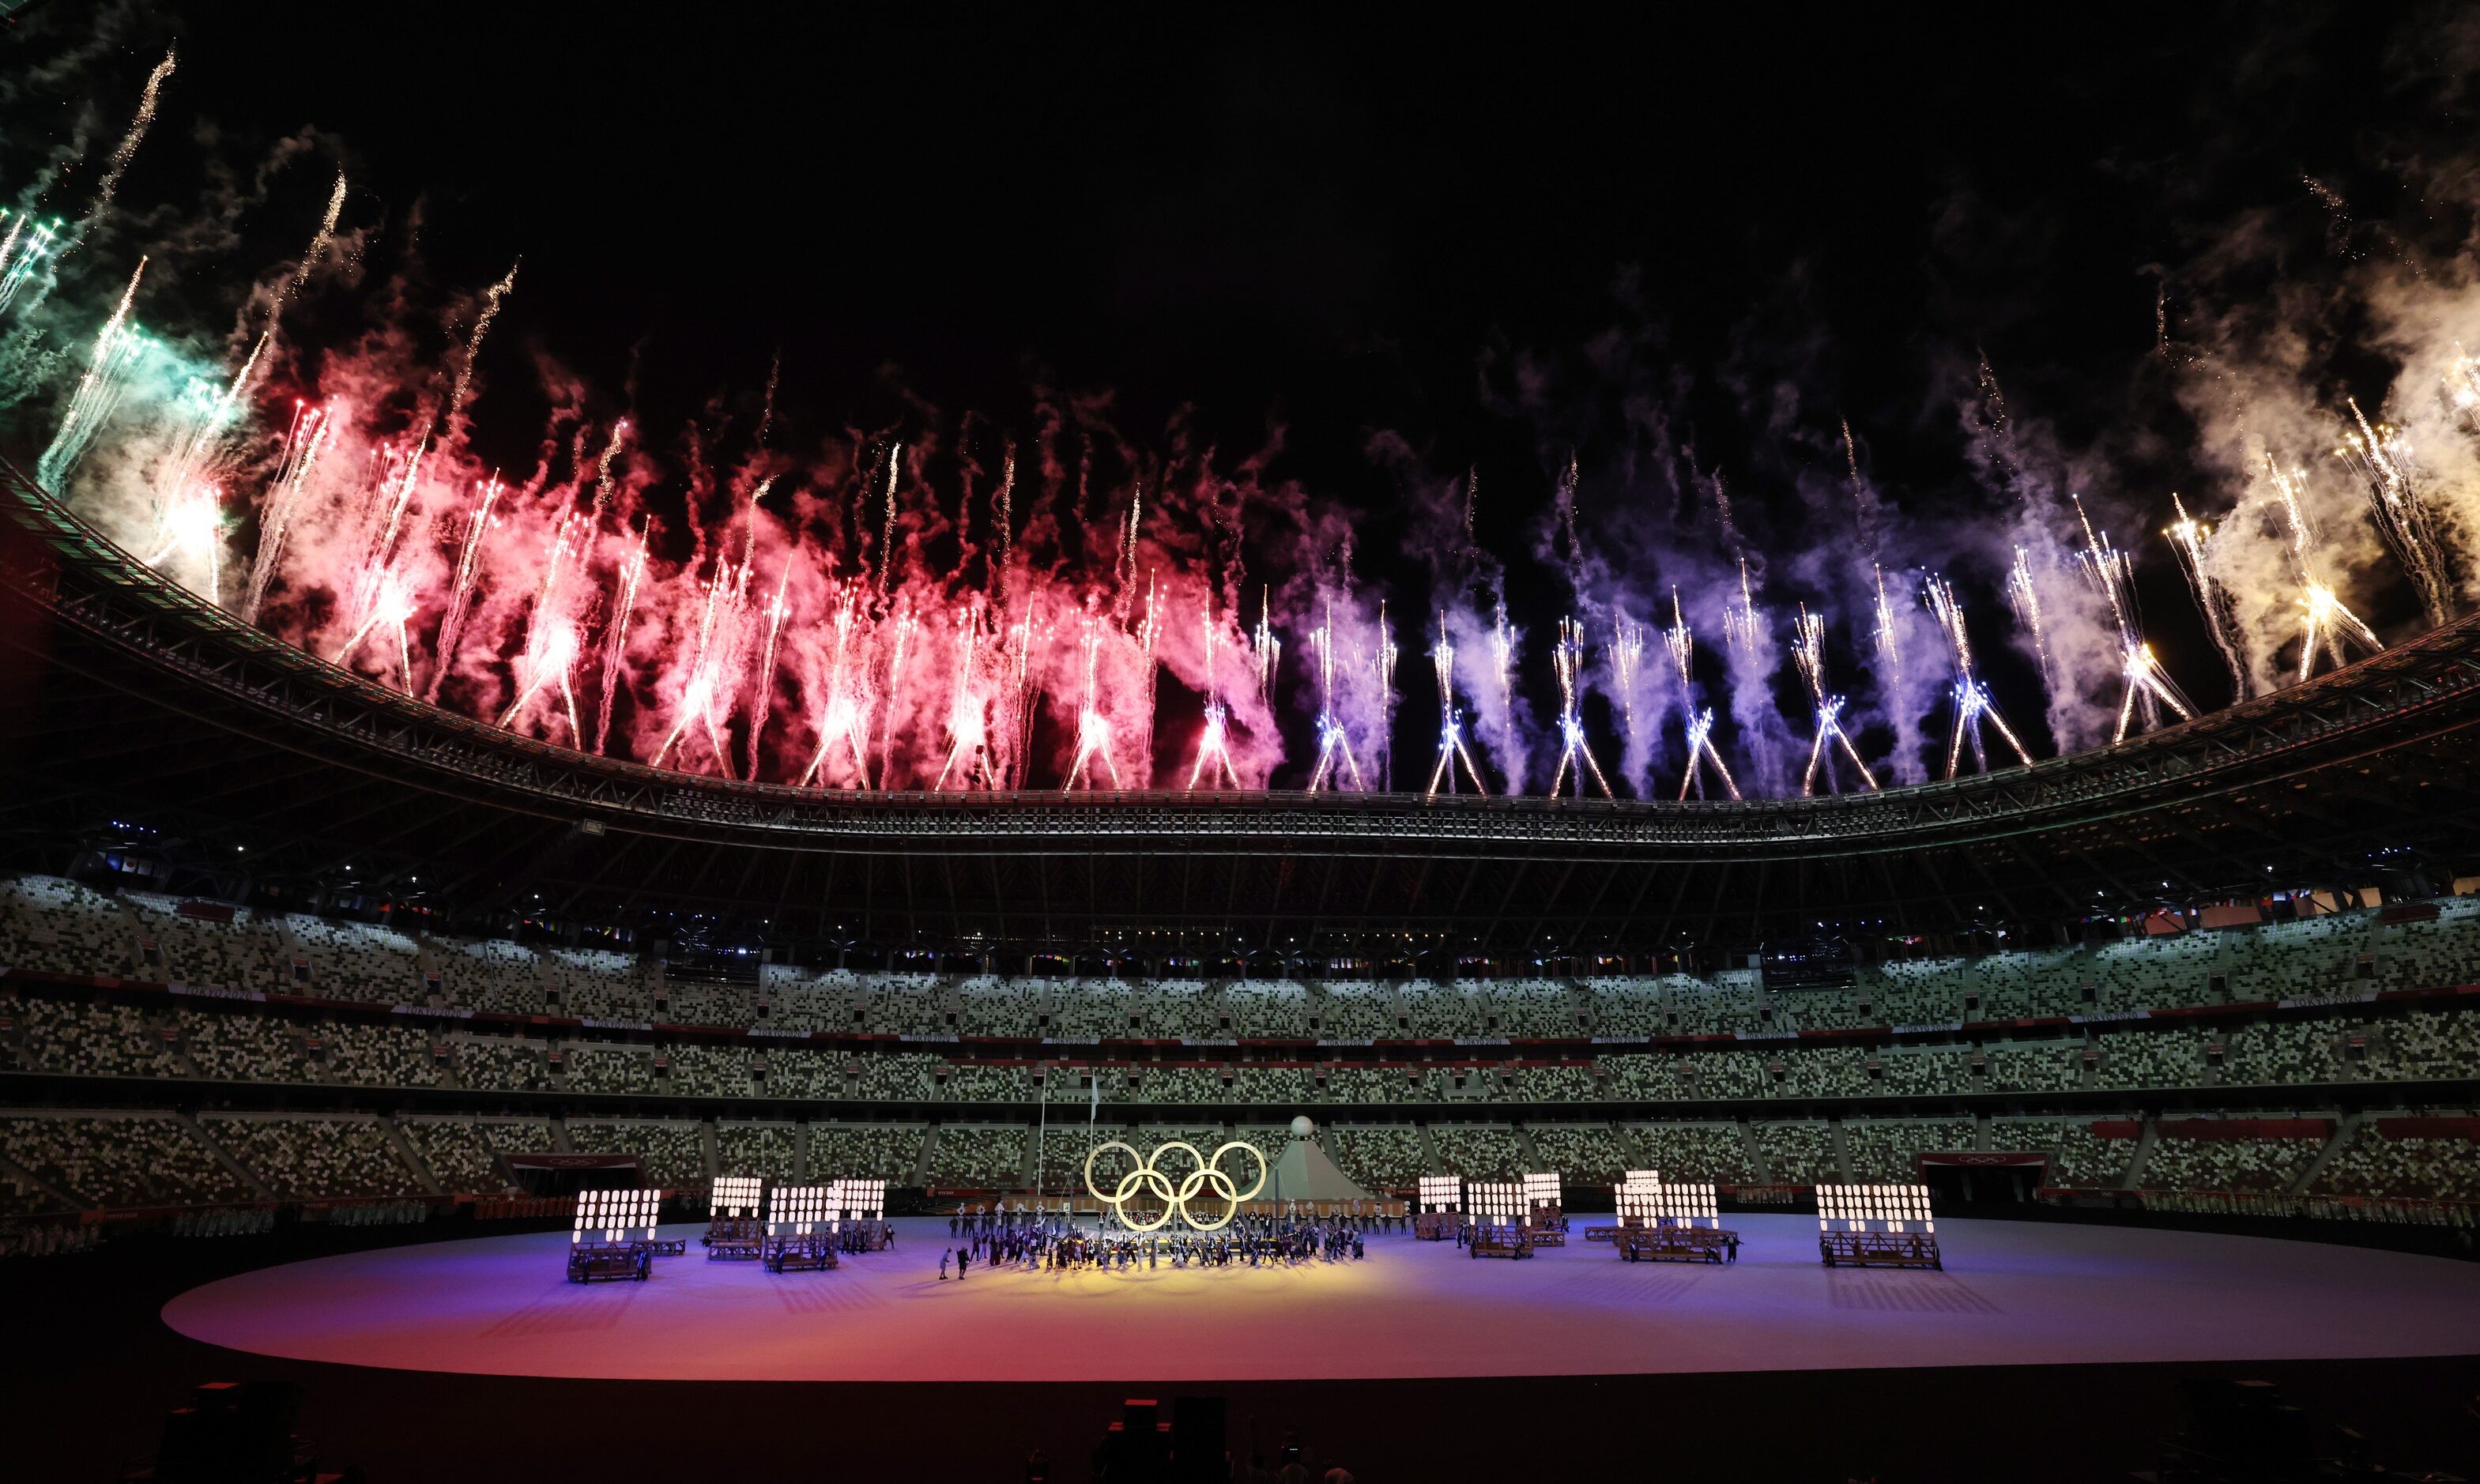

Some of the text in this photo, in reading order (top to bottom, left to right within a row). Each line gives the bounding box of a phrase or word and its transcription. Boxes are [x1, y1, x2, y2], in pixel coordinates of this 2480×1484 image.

[184, 987, 252, 1000] TOKYO 2020
[2293, 994, 2361, 1008] TOKYO 2020
[406, 1006, 462, 1017] TOKYO 2020
[594, 1020, 620, 1029] TOKYO
[2082, 1015, 2112, 1023] TOKYO
